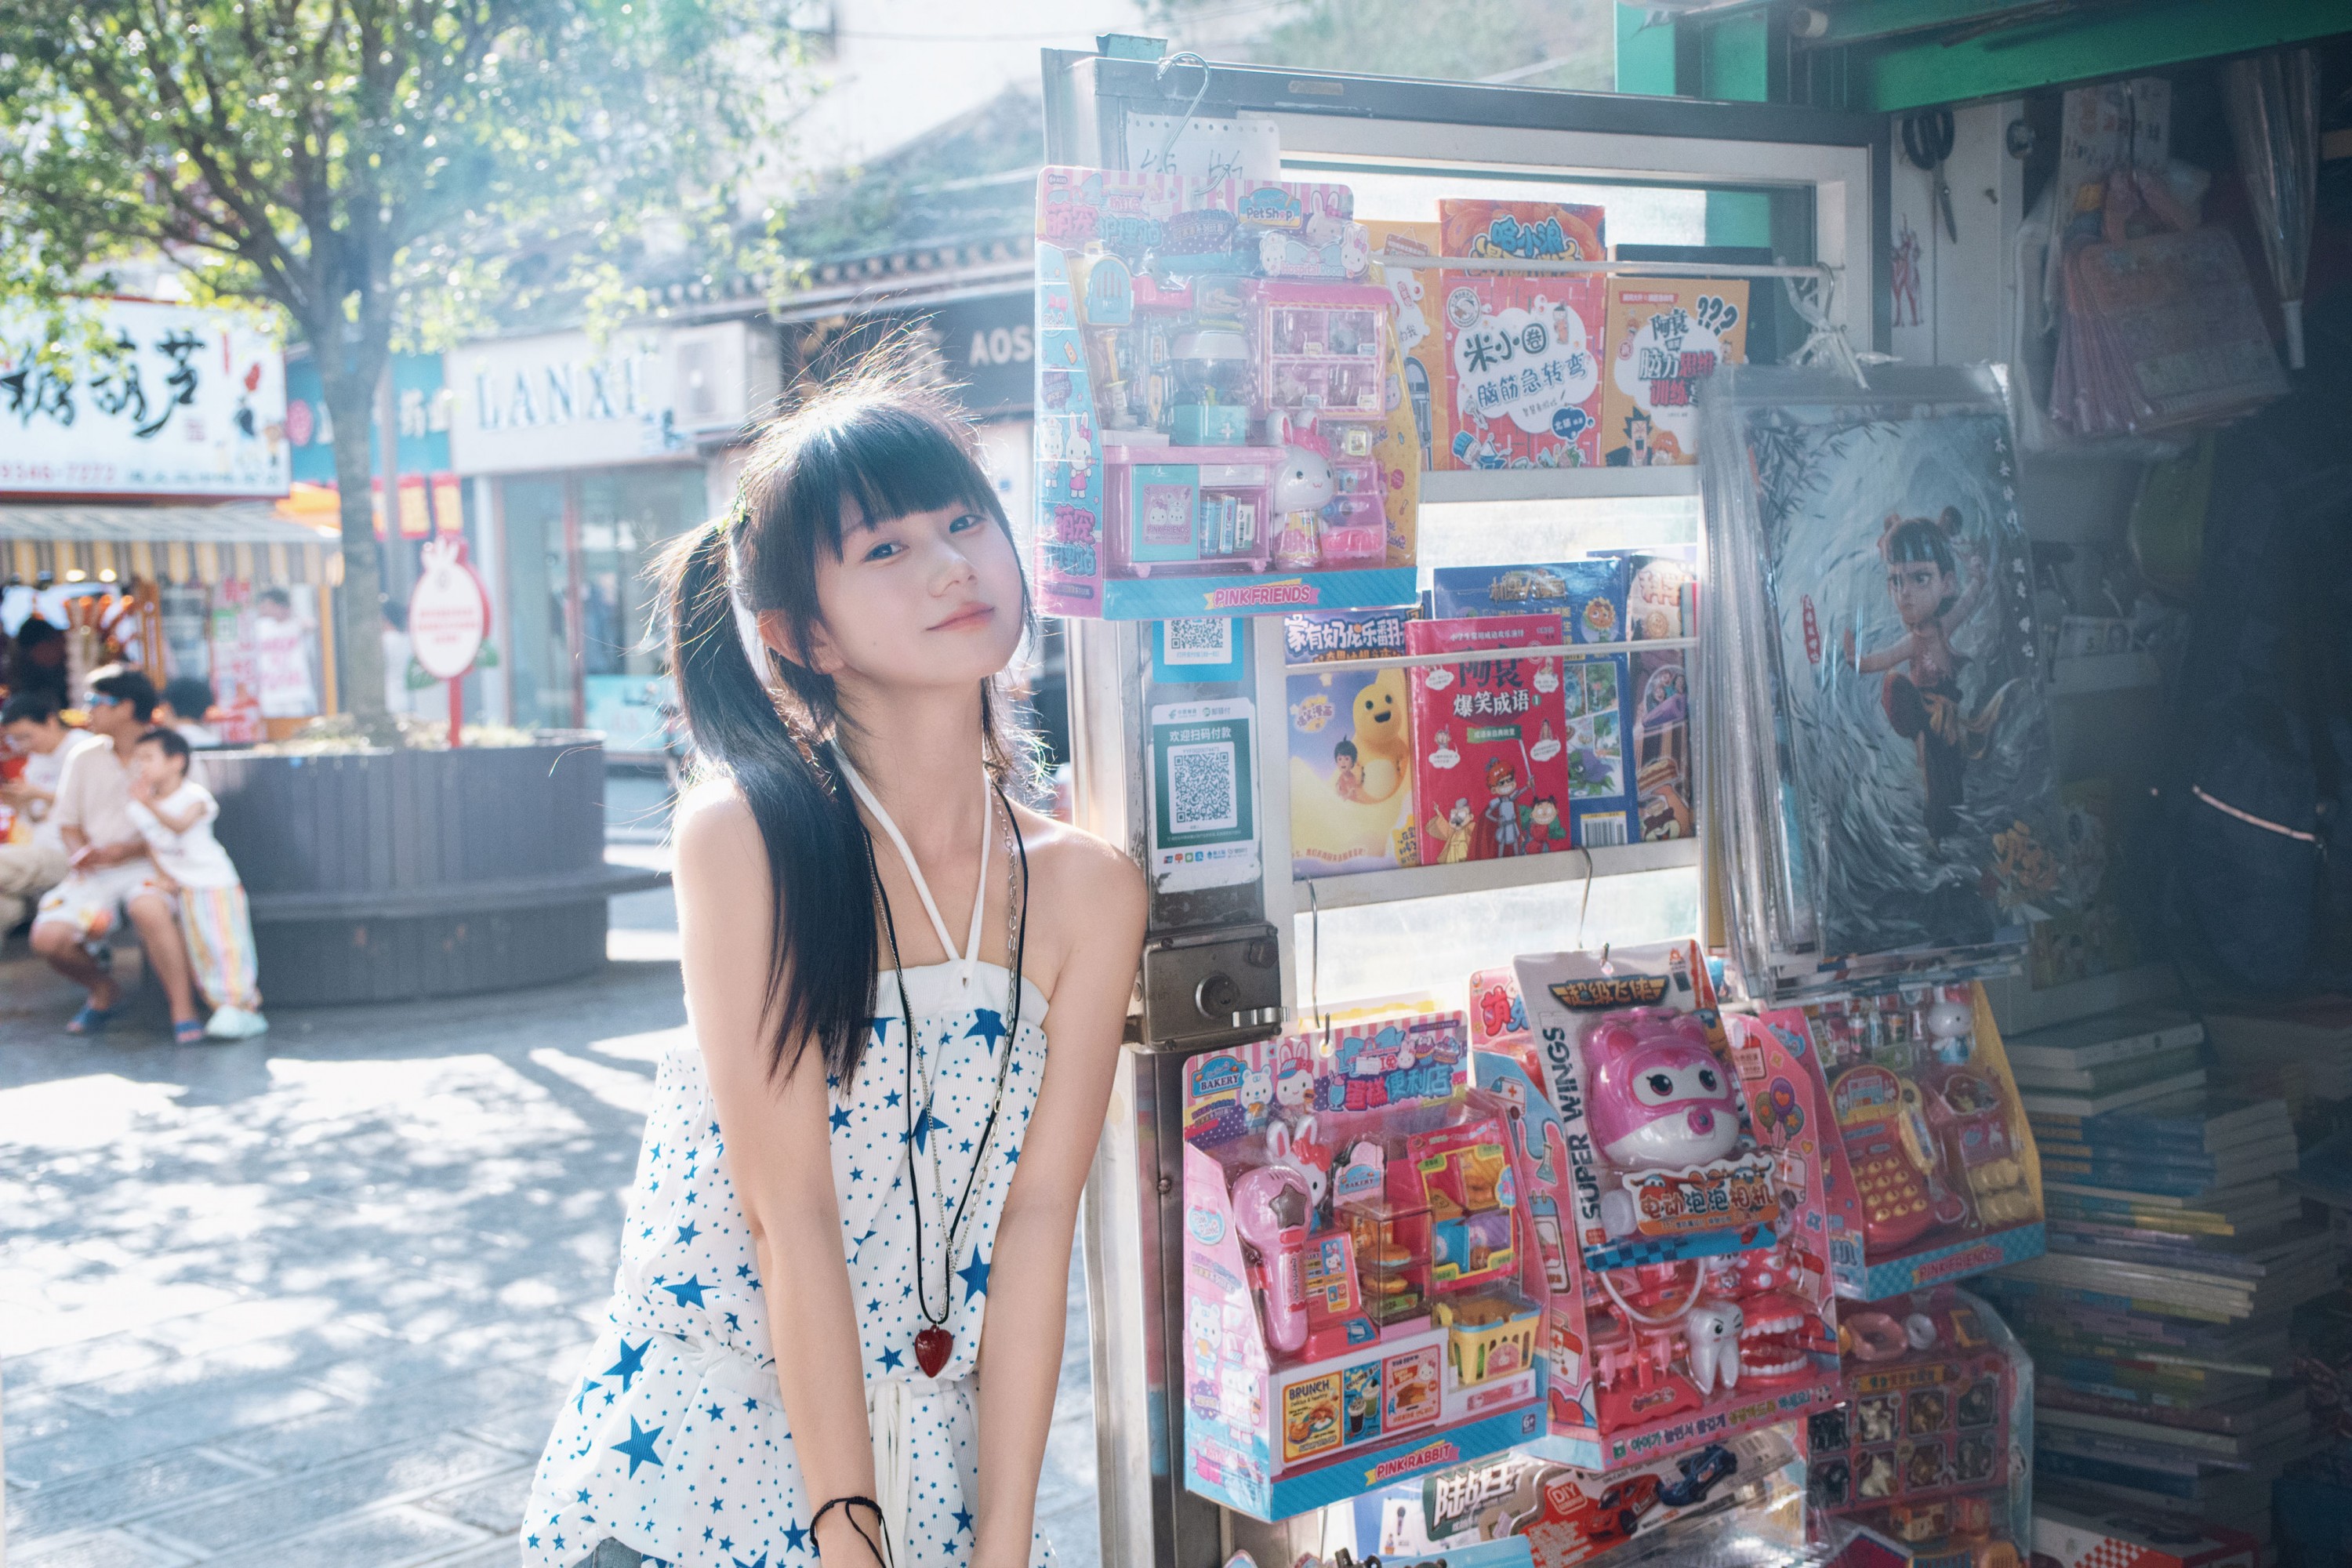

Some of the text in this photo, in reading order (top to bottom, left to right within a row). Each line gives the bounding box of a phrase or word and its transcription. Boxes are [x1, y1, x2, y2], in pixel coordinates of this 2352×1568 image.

[1280, 263, 1345, 277] Hospital Room
[969, 325, 1035, 367] AOS
[1464, 322, 1547, 372] 米小圈
[1639, 347, 1715, 379] 脑力思维
[1477, 352, 1586, 407] 脑筋急转弯
[1214, 584, 1311, 606] PINK FRIENDS
[1454, 688, 1529, 717] 爆笑成语
[1169, 727, 1232, 742] 欢迎扫码付款
[1566, 978, 1651, 1006] 超级飞侠
[1201, 1073, 1240, 1091] BAKERY
[1345, 1065, 1454, 1111] 蛋糕便利店
[1542, 1026, 1604, 1221] SUPER WINGS
[1345, 1178, 1374, 1189] BAKERY
[1640, 1183, 1773, 1219] 电动泡泡相机
[1289, 1379, 1330, 1400] BRUNCH
[1523, 1415, 1535, 1427] 6+
[1377, 1443, 1453, 1479] PINK RABBIT
[1434, 1463, 1519, 1528] 陆战王
[1553, 1483, 1579, 1503] DIY
